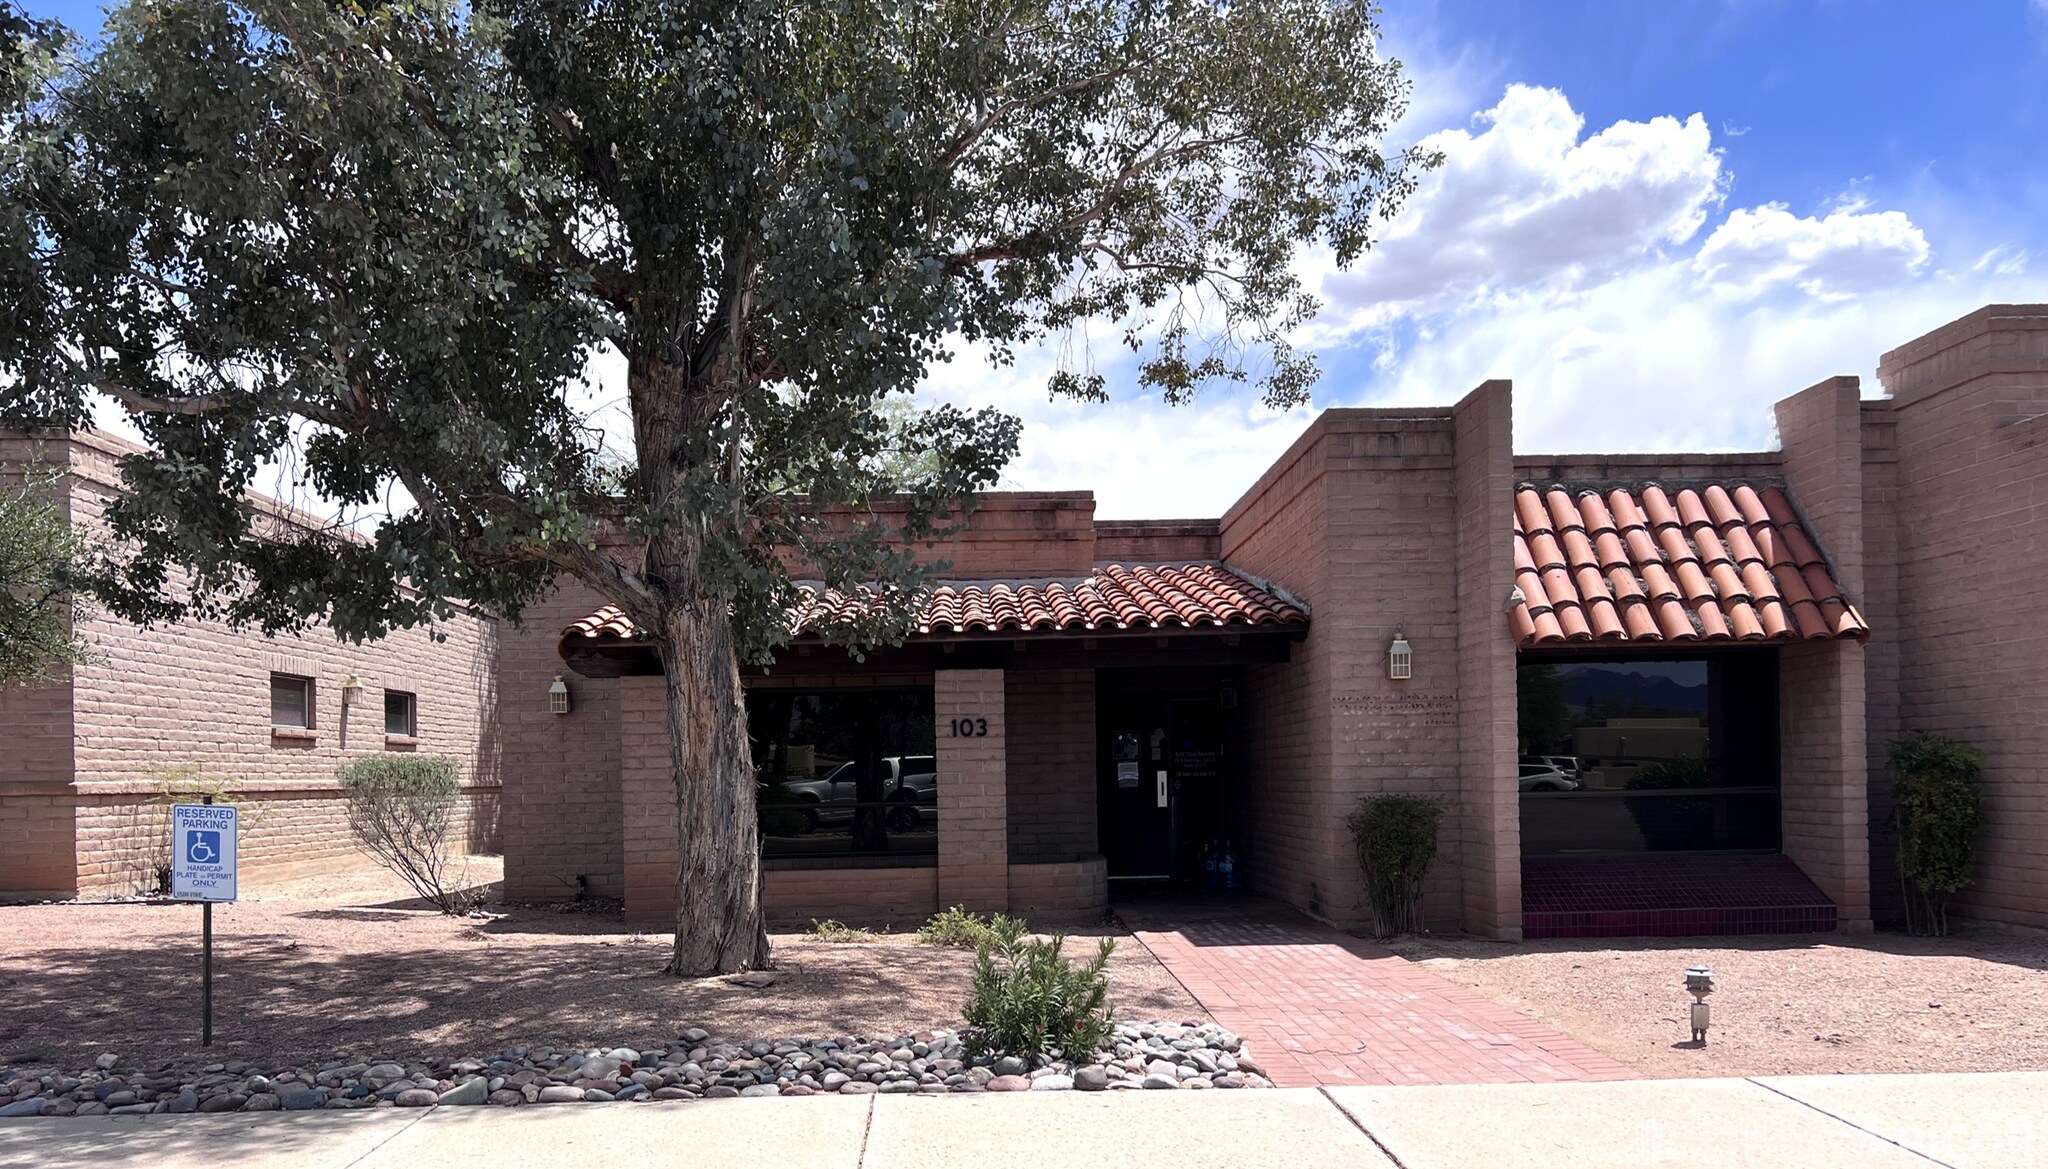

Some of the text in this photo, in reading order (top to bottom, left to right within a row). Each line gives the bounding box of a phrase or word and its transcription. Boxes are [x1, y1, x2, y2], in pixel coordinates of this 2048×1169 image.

[951, 718, 987, 737] 103
[177, 808, 233, 819] RESERVED
[182, 819, 228, 829] PARKING
[176, 871, 197, 879] PLATE
